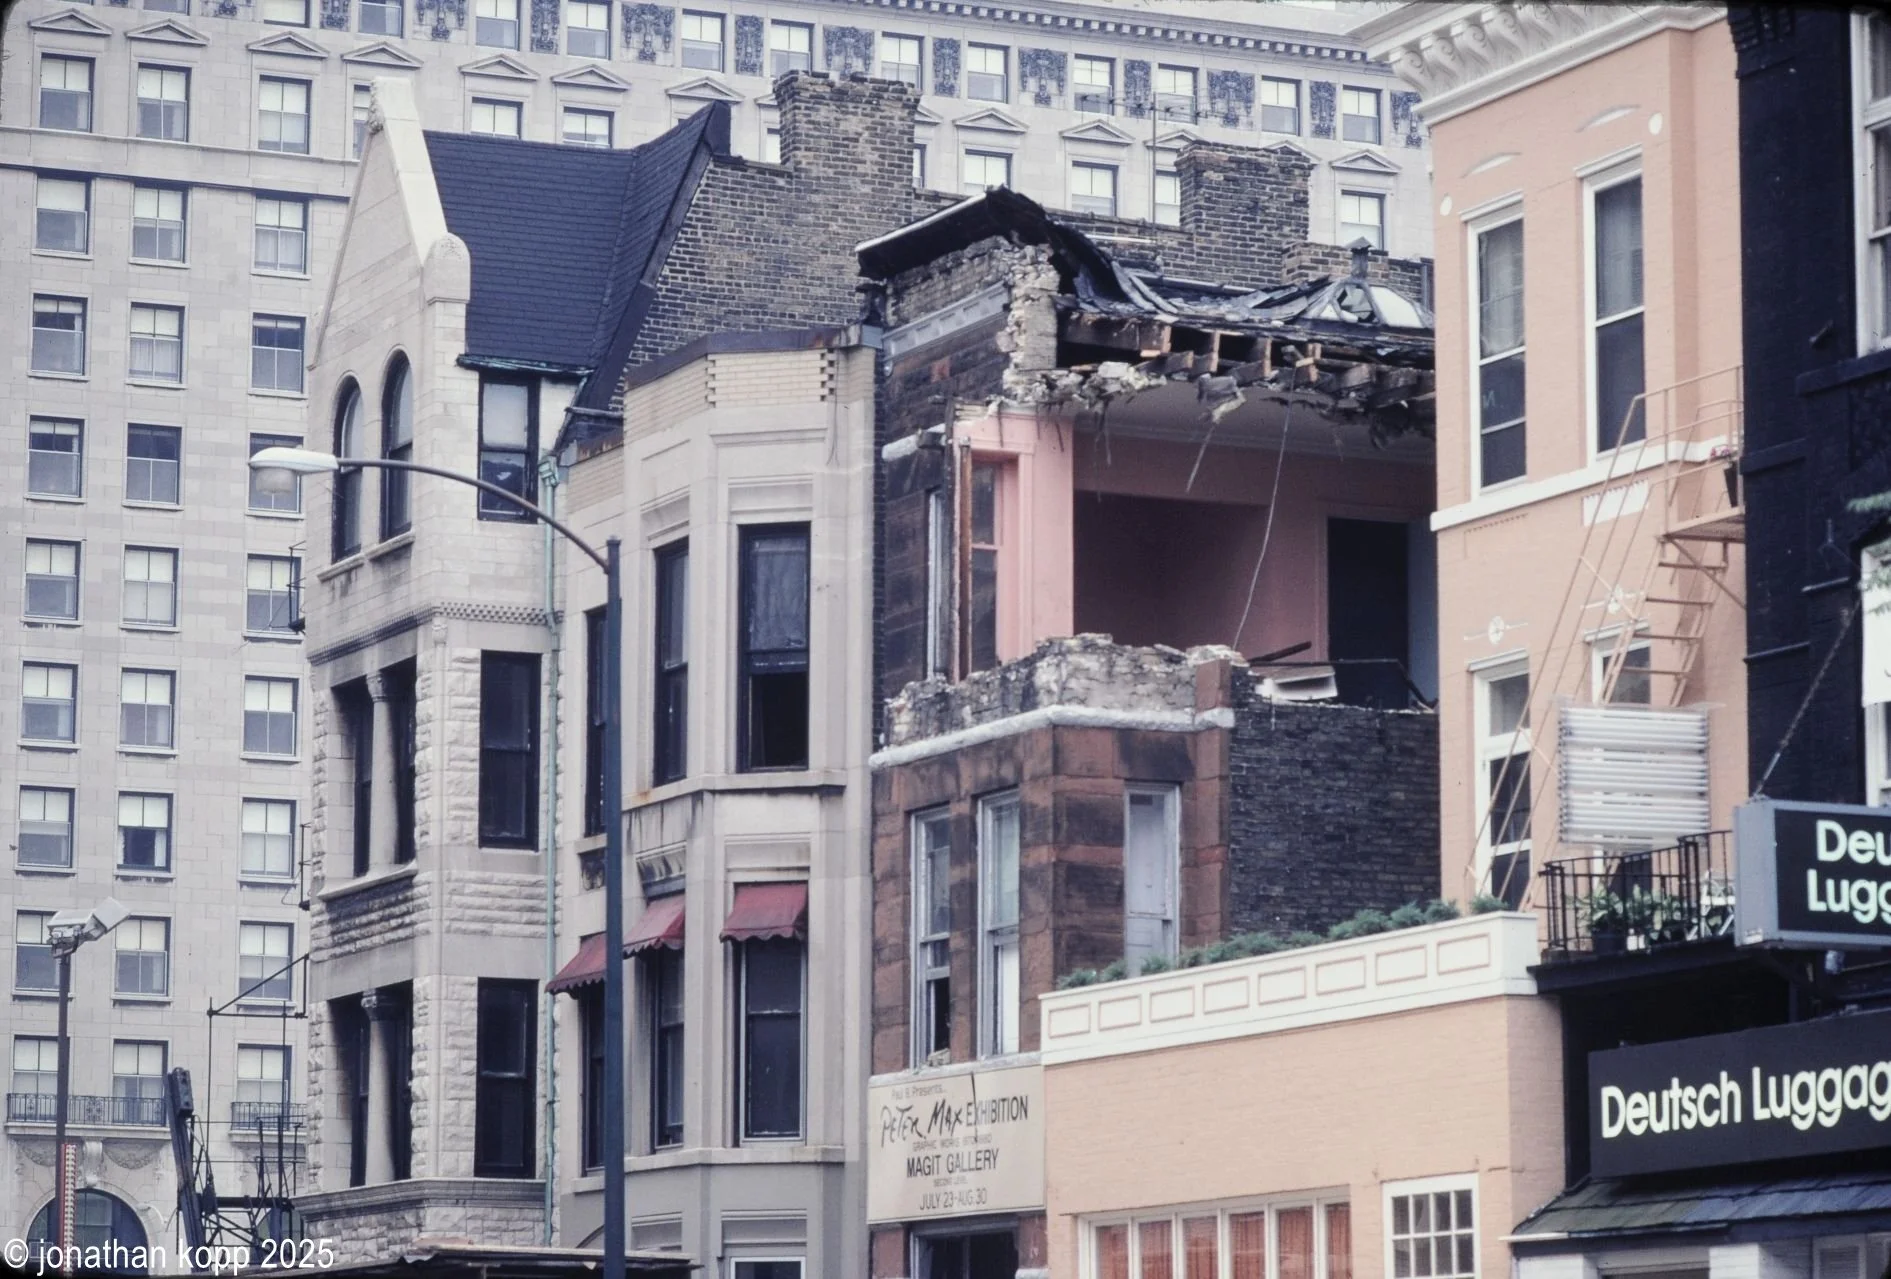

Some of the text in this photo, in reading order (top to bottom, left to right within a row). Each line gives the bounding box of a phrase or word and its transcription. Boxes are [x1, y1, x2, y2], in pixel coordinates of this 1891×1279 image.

[1816, 819, 1891, 866] Deu
[1601, 1060, 1891, 1138] Deutsch Luggag
[907, 1148, 999, 1178] MAGIT GALLERY
[919, 1191, 940, 1211] JULY
